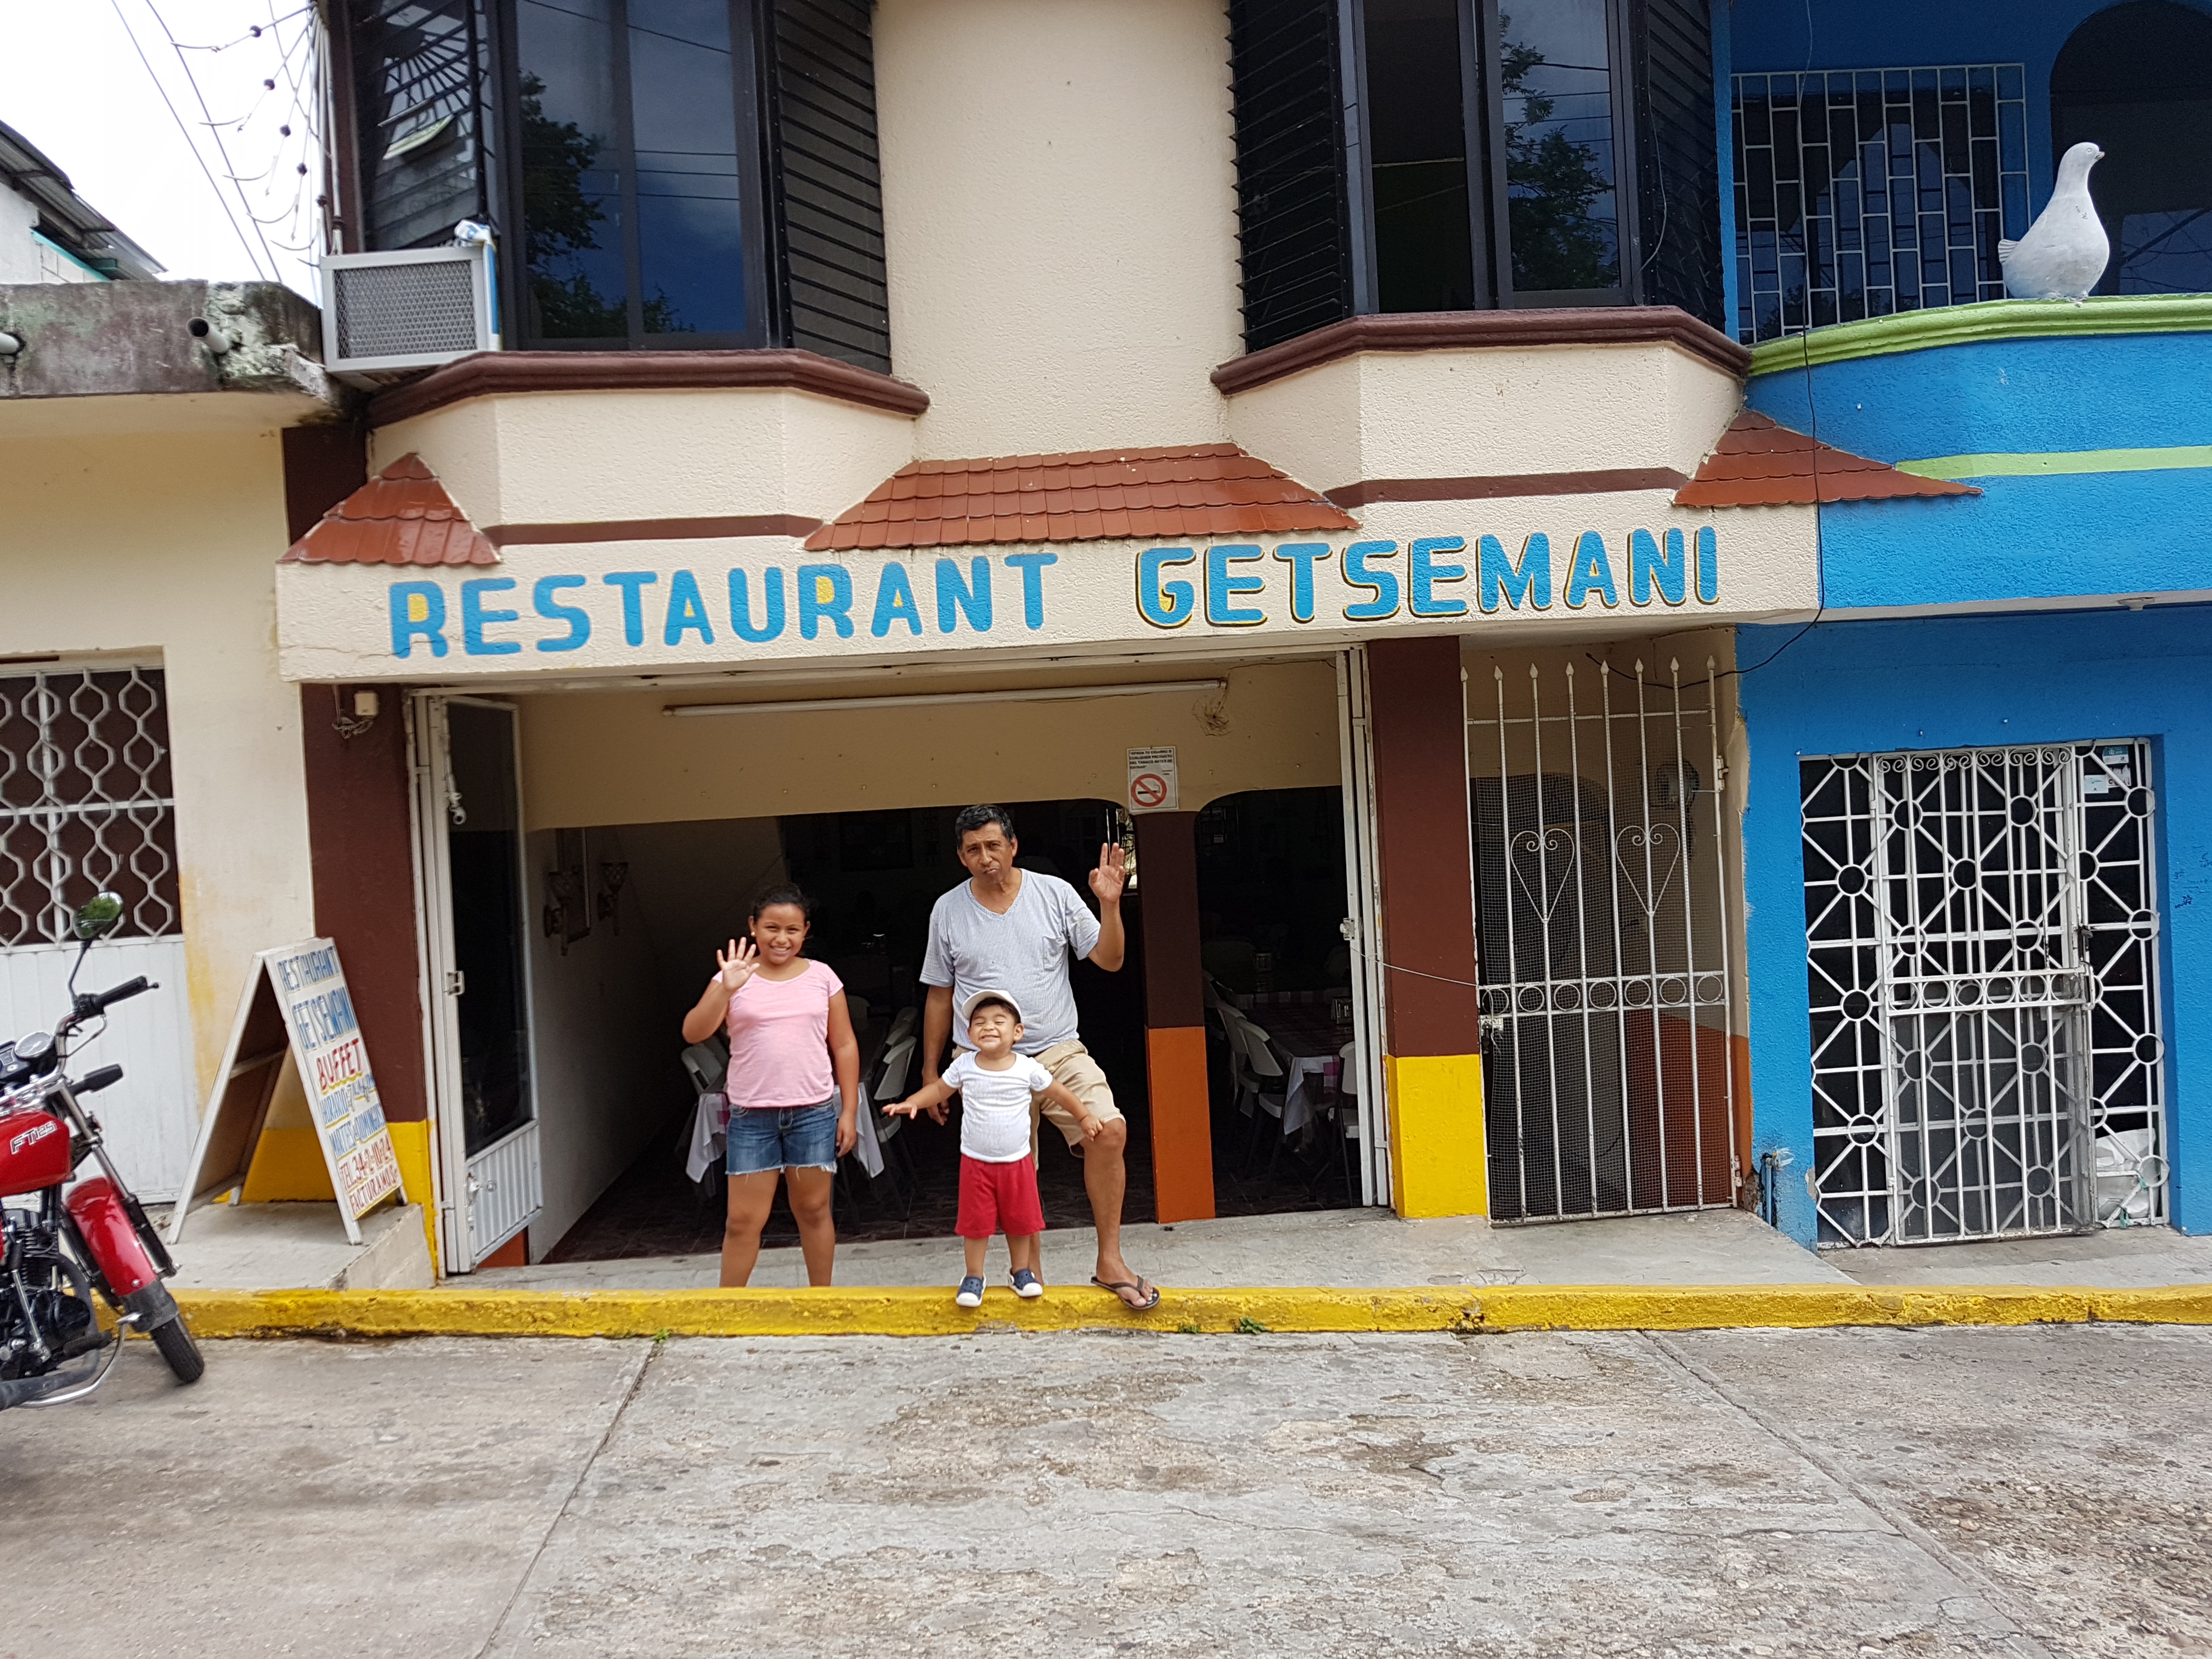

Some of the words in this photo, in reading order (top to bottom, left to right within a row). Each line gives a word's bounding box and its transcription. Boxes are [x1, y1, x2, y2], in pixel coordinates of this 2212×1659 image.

[388, 552, 1058, 659] RESTAURANT
[1136, 526, 1720, 629] GETSEMANI
[276, 946, 340, 992] RESTAURANT
[292, 986, 358, 1049] GETSEMANI
[317, 1037, 363, 1091] BUFFET
